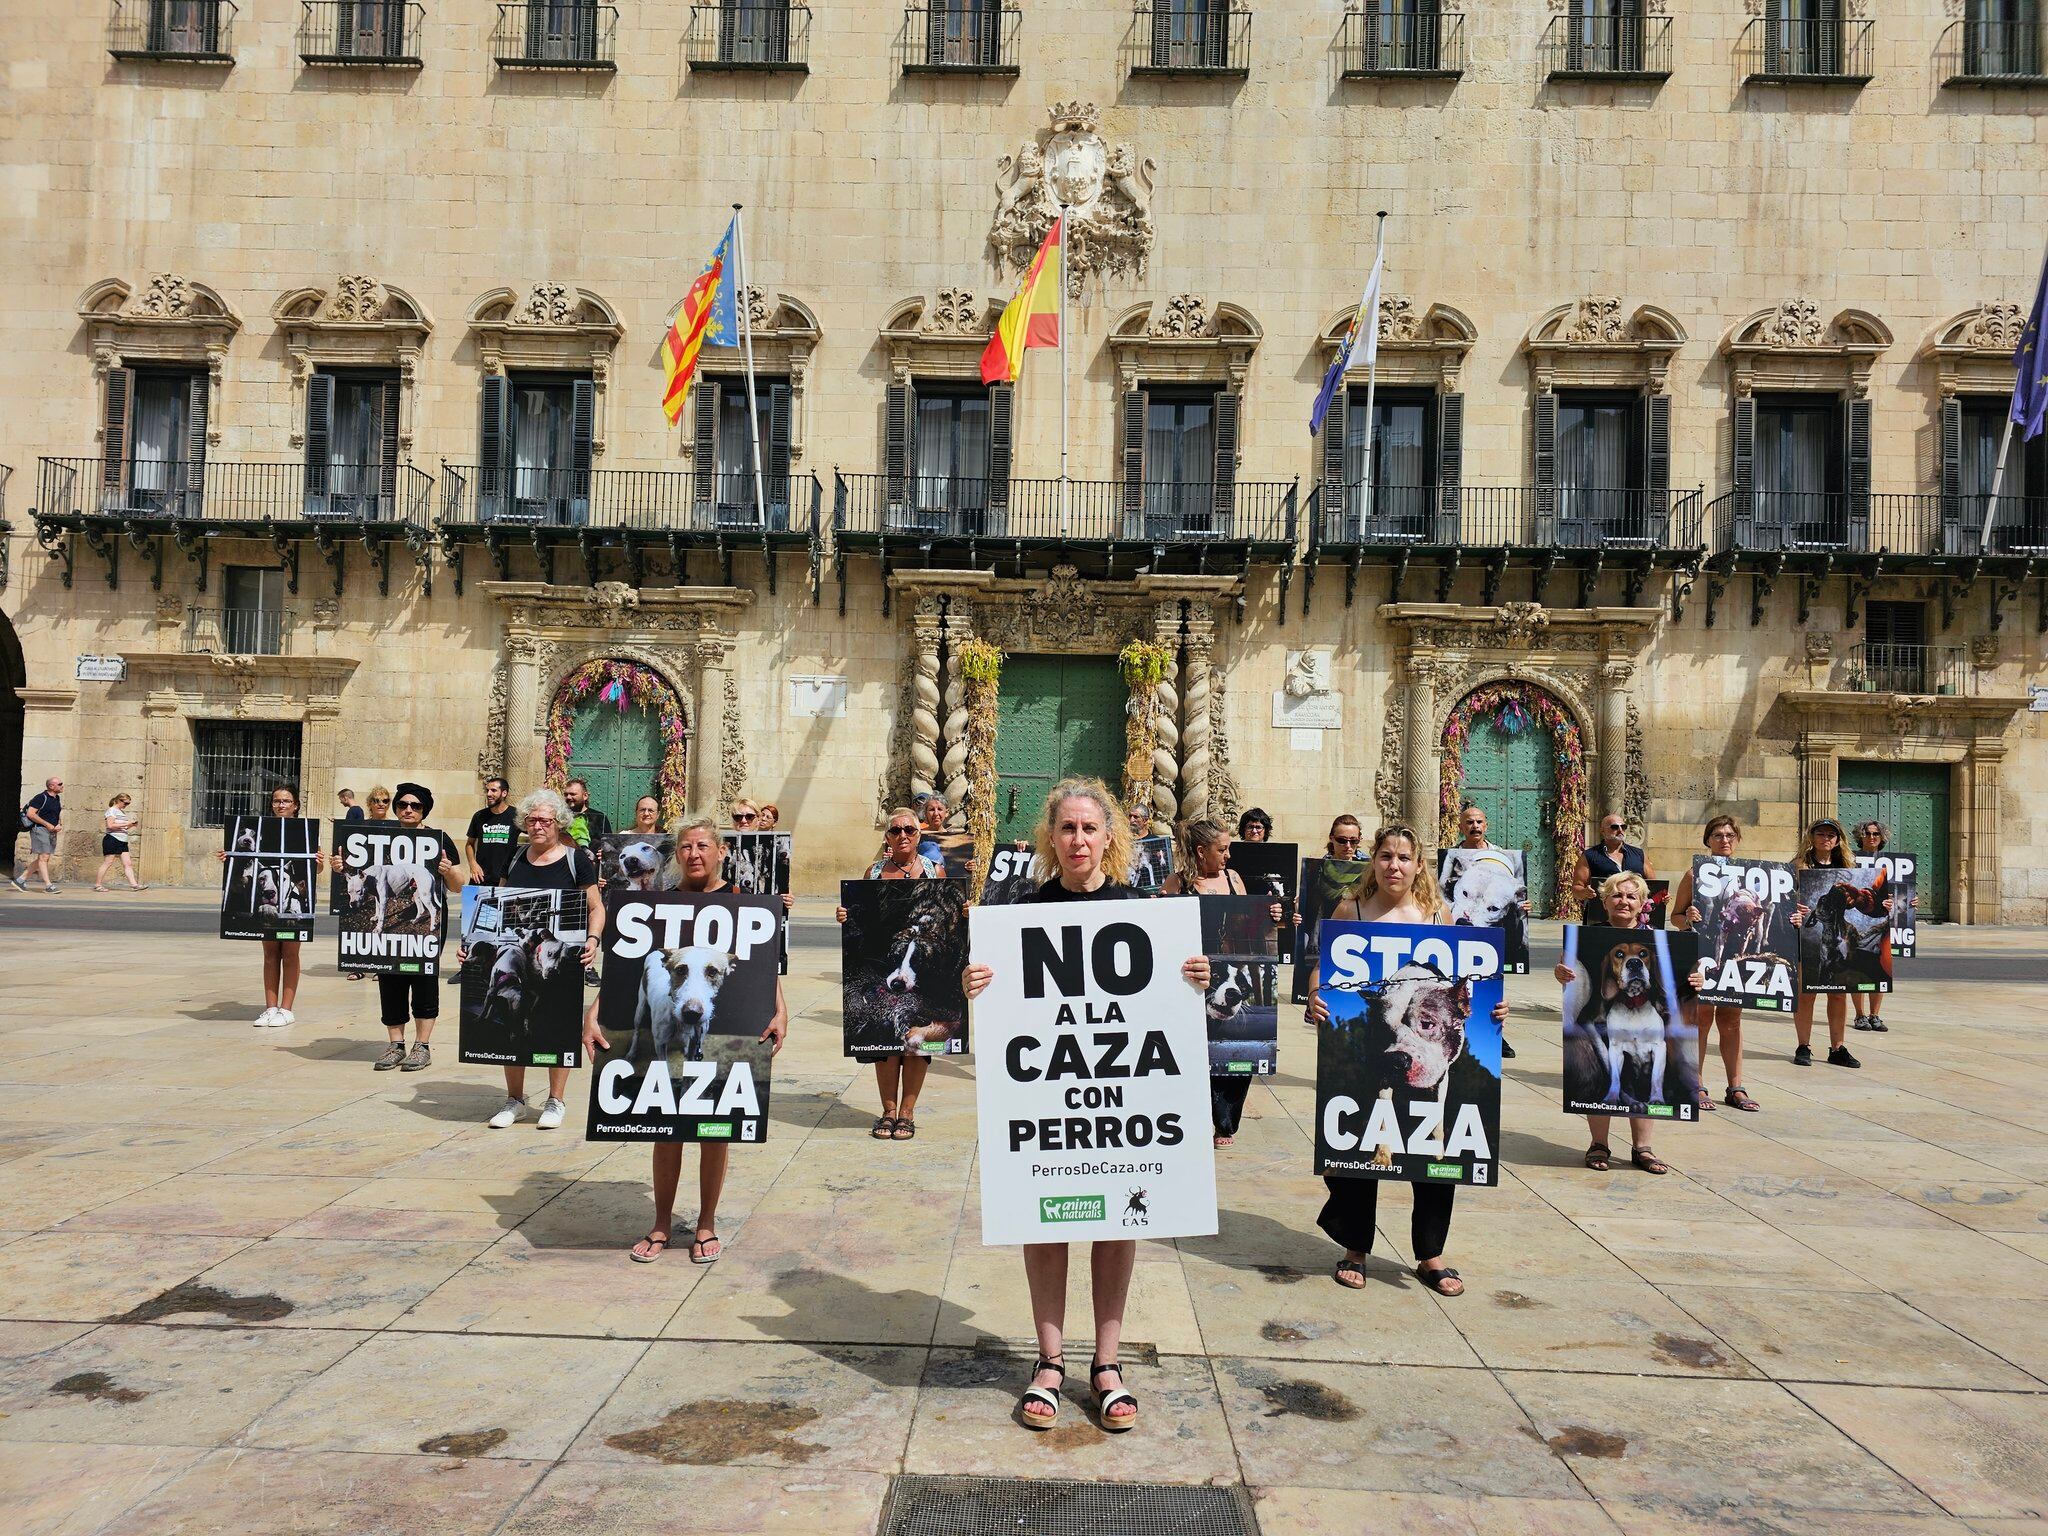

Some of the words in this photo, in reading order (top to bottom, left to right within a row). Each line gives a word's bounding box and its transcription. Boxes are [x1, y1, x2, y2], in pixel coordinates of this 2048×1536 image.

[345, 833, 439, 868] STOP
[990, 851, 1036, 881] ST
[1856, 856, 1914, 882] TOP
[1698, 863, 1794, 903] STOP
[611, 902, 775, 960] STOP
[341, 931, 438, 958] HUNTING
[341, 962, 393, 971] SaveHuntingDogs.org
[1021, 922, 1153, 998] NO
[1329, 934, 1499, 998] STOP
[1698, 956, 1794, 997] CAZA
[1055, 1003, 1077, 1025] A
[1085, 1001, 1126, 1024] LA
[465, 1051, 517, 1061] PerrosDeCaza.org
[851, 1044, 905, 1052] PerrosDeCaza.org
[1005, 1030, 1181, 1082] CAZA
[597, 1059, 761, 1116] CAZA
[1064, 1085, 1123, 1109] CON
[1570, 1101, 1630, 1112] PerrosDeCaza.org
[596, 1124, 673, 1135] PerrosDeCaza.org
[1009, 1112, 1184, 1152] PERROS
[1323, 1095, 1492, 1159] CAZA
[1032, 1162, 1163, 1177] PerrosDeCaza.org
[1324, 1159, 1403, 1173] PerrosDeCaza.org
[1062, 1198, 1101, 1210] anima
[1062, 1208, 1102, 1220] naturalis
[1122, 1217, 1149, 1226] CAS
